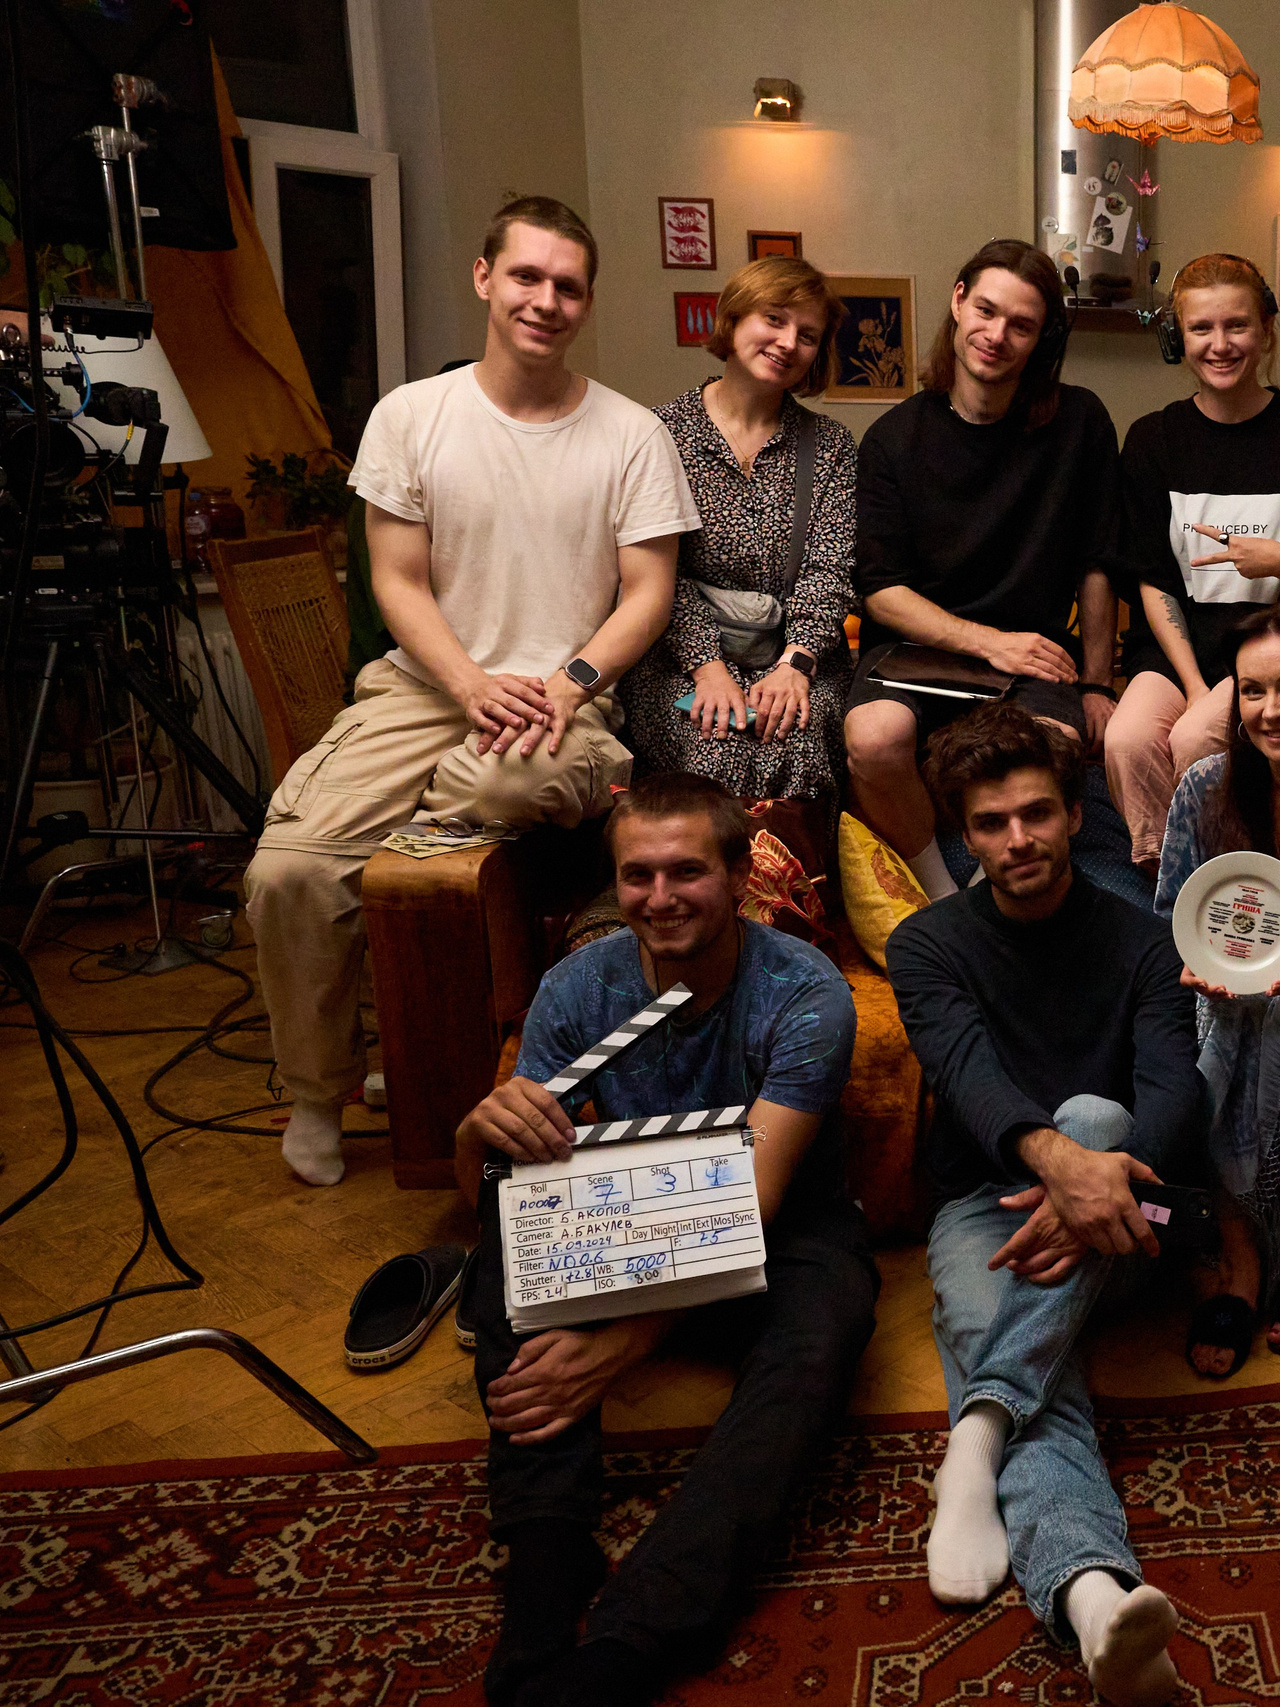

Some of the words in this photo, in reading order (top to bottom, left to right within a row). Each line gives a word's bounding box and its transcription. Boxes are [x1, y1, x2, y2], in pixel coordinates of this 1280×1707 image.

[1252, 524, 1268, 534] BY
[1232, 902, 1261, 914] ГРИША
[710, 1157, 729, 1167] Take
[650, 1166, 670, 1177] Shot
[587, 1175, 614, 1186] Scene
[656, 1173, 677, 1193] 3
[530, 1184, 547, 1194] Roll
[594, 1183, 622, 1205] 7
[515, 1216, 554, 1229] Director:
[632, 1229, 648, 1241] Day
[653, 1225, 677, 1238] Night
[680, 1222, 692, 1232] Int
[696, 1219, 710, 1229] Ext
[713, 1215, 732, 1226] Mos
[734, 1213, 755, 1226] Sync
[516, 1231, 553, 1243] Camera:
[674, 1238, 682, 1247] F:
[546, 1236, 612, 1255] 15.09.2024
[518, 1248, 541, 1258] Date:
[519, 1262, 544, 1272] Filter:
[623, 1252, 667, 1274] 5000
[596, 1264, 615, 1275] WB:
[520, 1275, 556, 1288] Shutter:
[633, 1269, 660, 1285] 800
[598, 1279, 616, 1289] ISO:
[521, 1290, 541, 1303] FPS:
[544, 1286, 563, 1298] 24
[352, 1355, 386, 1364] crocs
